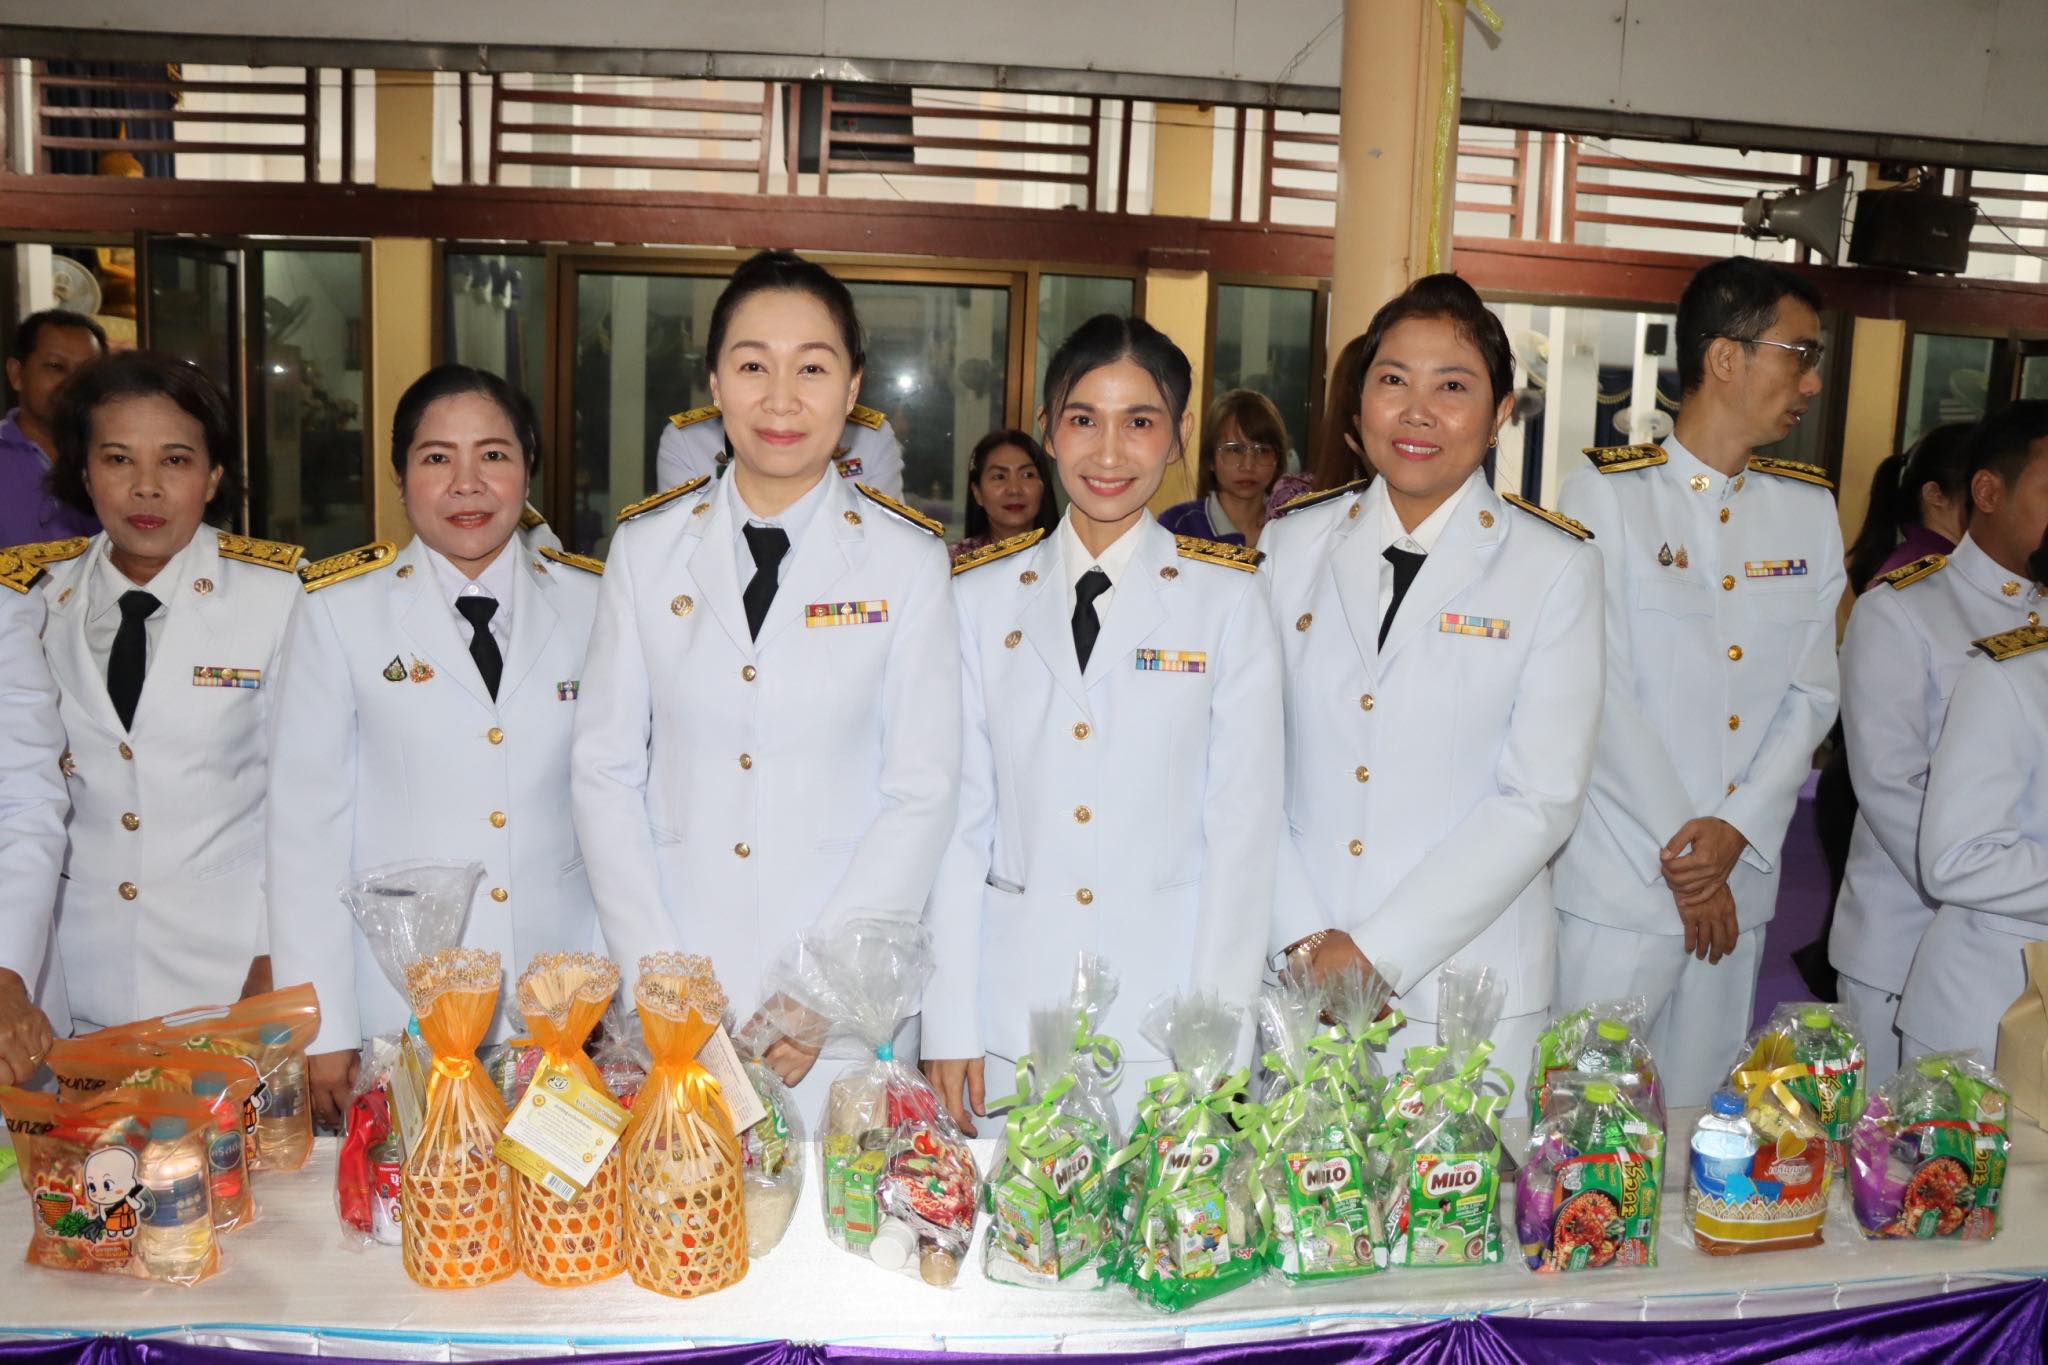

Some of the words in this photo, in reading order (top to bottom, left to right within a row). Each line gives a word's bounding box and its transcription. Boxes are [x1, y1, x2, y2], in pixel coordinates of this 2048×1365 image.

[1170, 1153, 1213, 1170] MIO
[1055, 1154, 1089, 1191] MILO
[1306, 1166, 1346, 1187] MILO
[1430, 1170, 1477, 1191] MILO
